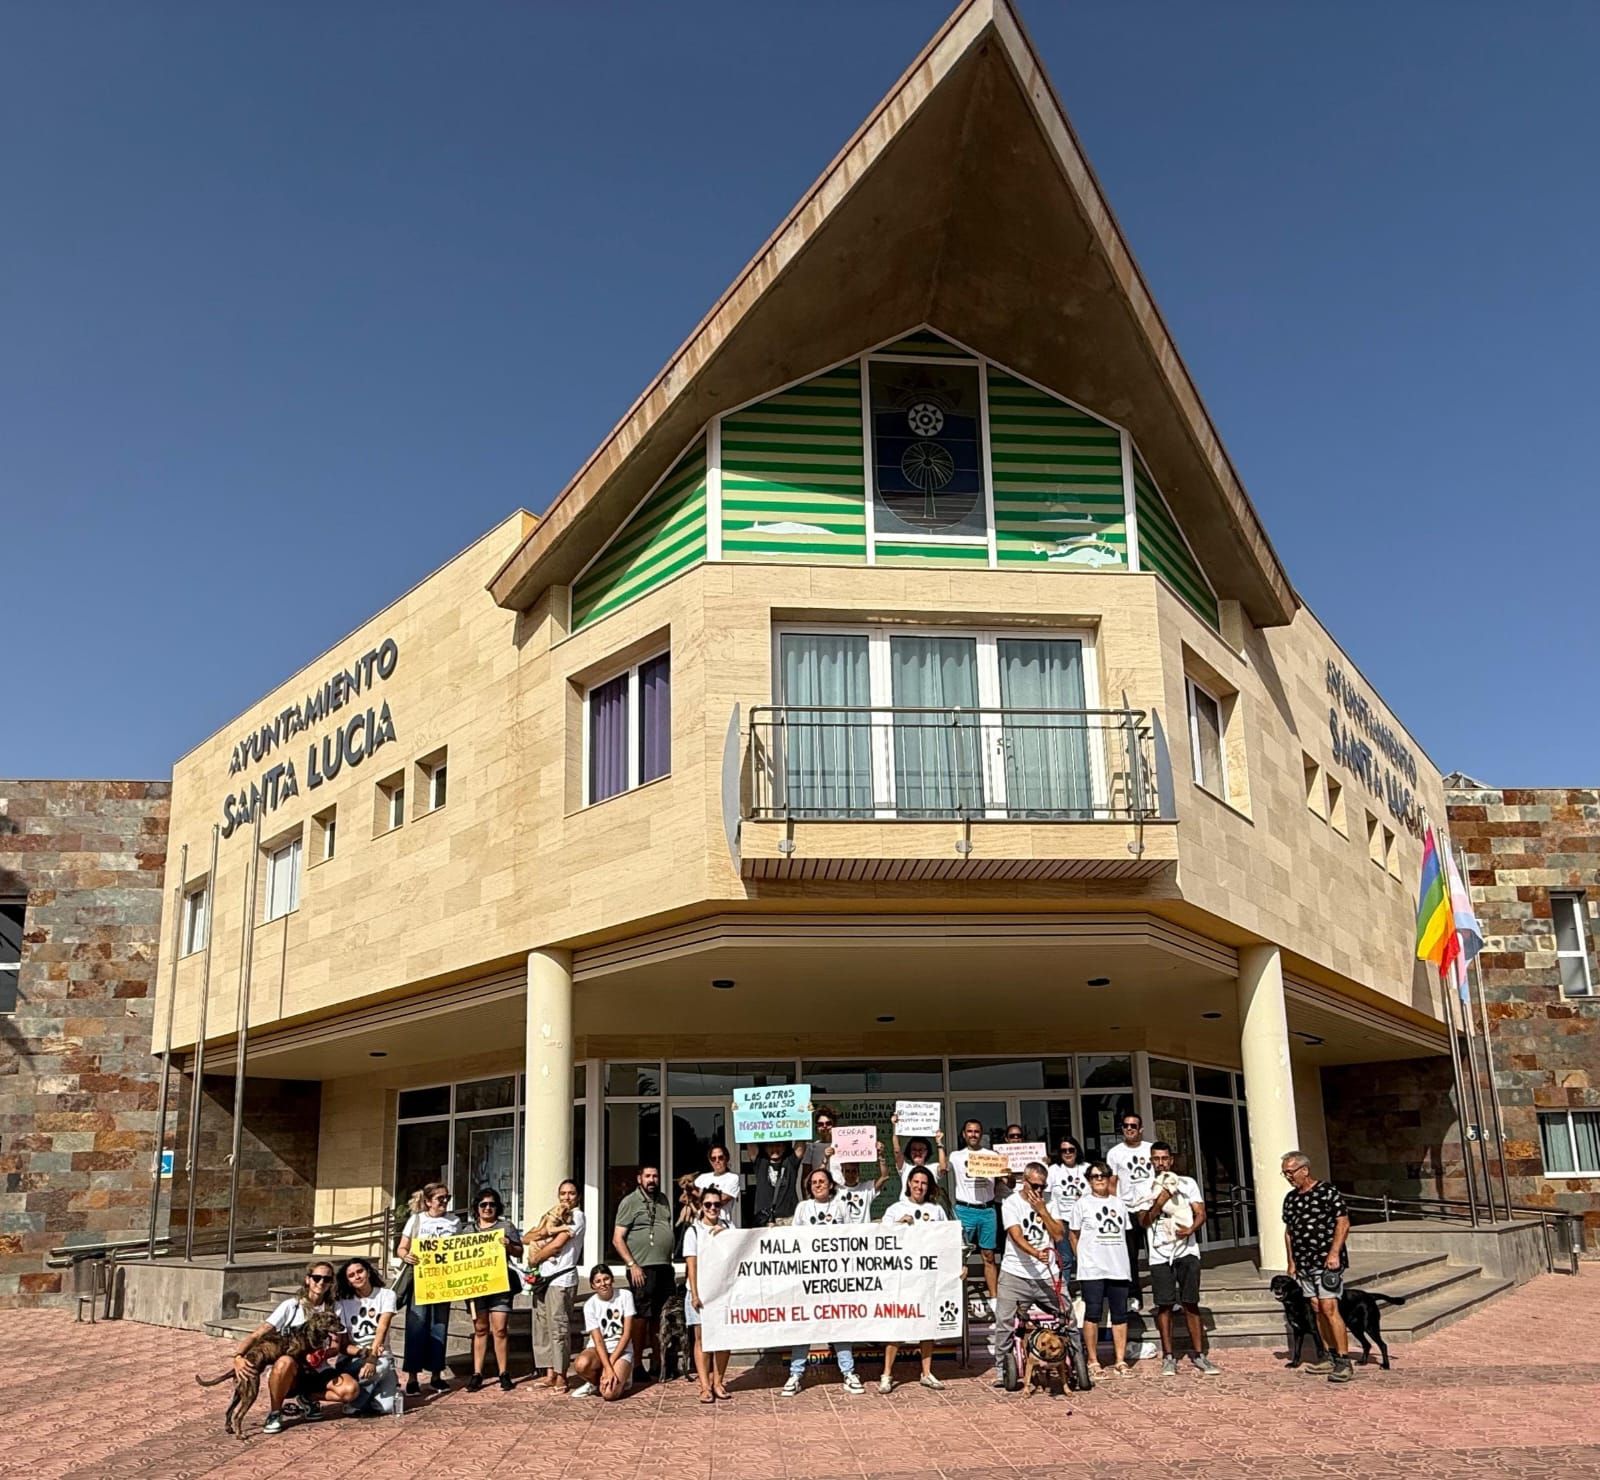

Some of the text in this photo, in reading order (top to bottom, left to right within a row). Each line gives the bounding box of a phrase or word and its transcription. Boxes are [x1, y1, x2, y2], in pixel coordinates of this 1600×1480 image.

[228, 638, 398, 778] AYUNTAMIENTO
[1329, 707, 1384, 803] SANTA
[221, 698, 397, 839] SANTA LUCIA
[744, 1089, 795, 1101] LOS OTROS
[837, 1127, 867, 1136] CERRAR
[419, 1232, 498, 1252] NOS SEPARARON
[760, 1236, 903, 1255] MALA GESTION DEL
[435, 1247, 485, 1264] DE ELLOS
[442, 1265, 452, 1276] NO
[464, 1261, 473, 1271] LA
[737, 1255, 938, 1277] AYUNTAMIENTO Y NORMAS DE
[792, 1305, 810, 1322] EL
[814, 1303, 868, 1320] CENTRO
